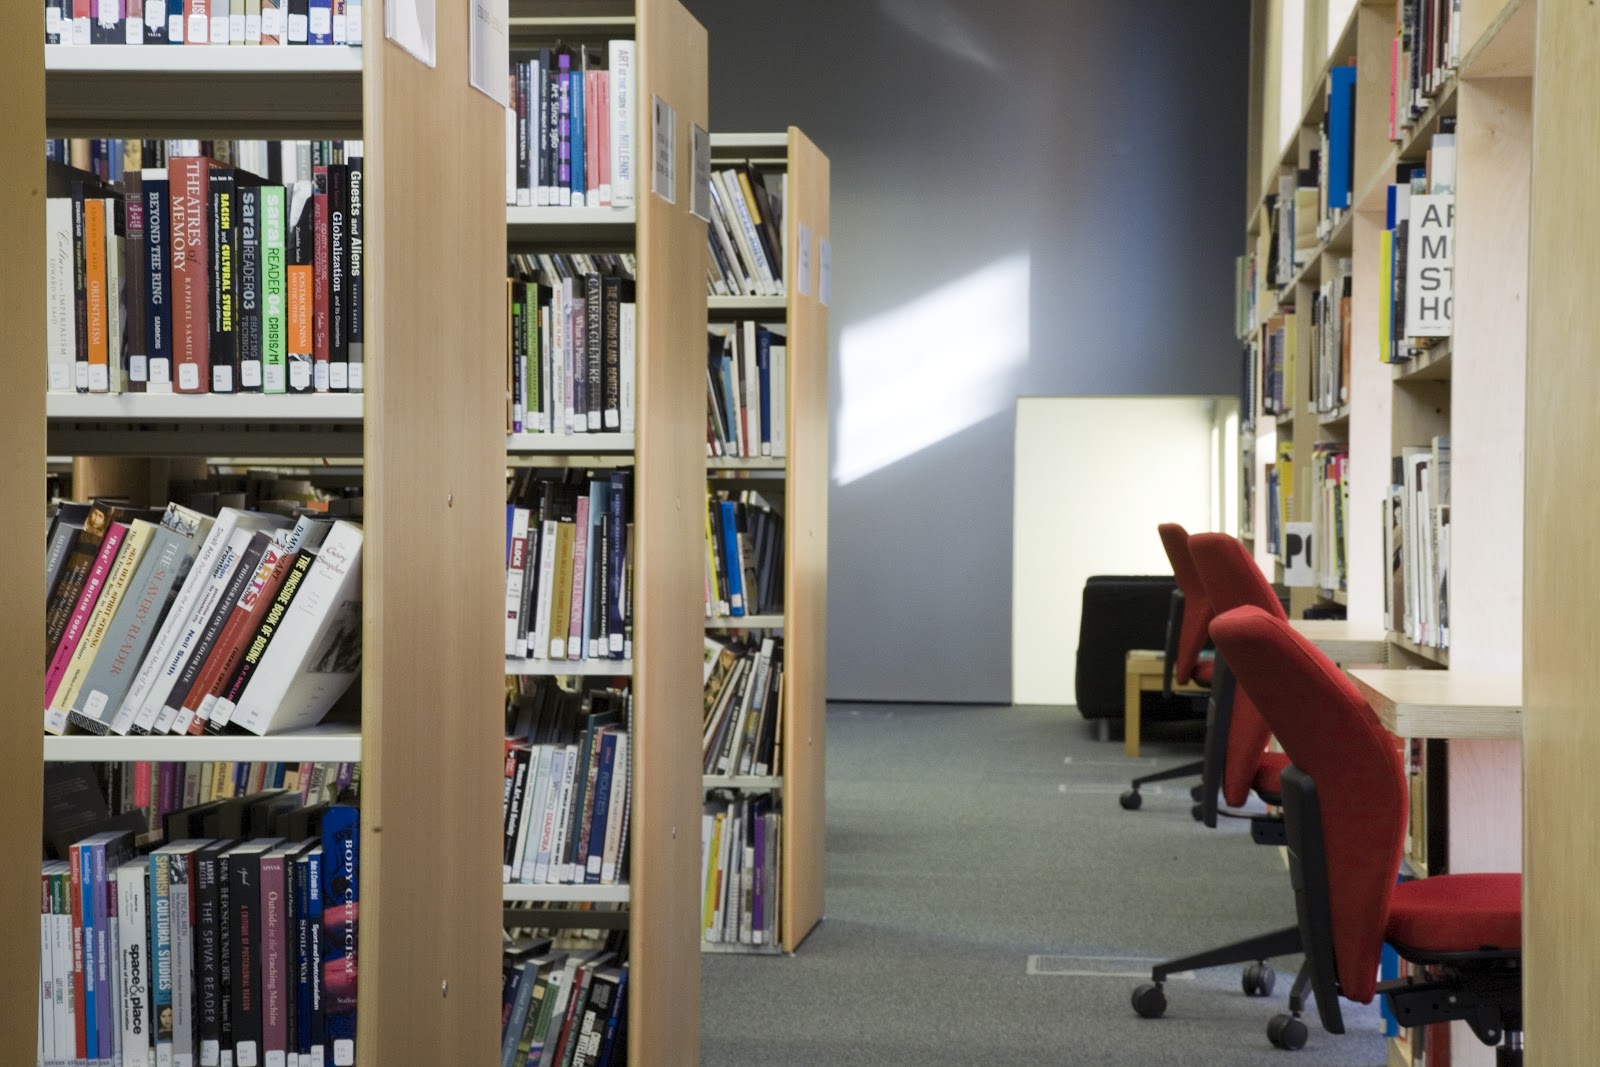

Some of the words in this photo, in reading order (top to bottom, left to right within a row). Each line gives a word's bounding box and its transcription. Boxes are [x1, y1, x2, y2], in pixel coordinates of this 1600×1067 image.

[618, 50, 629, 68] ART
[551, 84, 560, 98] Art
[550, 102, 560, 126] Since
[549, 128, 559, 149] 1960
[186, 160, 201, 247] THEATRES
[350, 171, 362, 216] Guests
[148, 192, 161, 244] BEYOND
[221, 193, 230, 230] RACISM
[351, 218, 359, 236] and
[171, 196, 186, 272] MEMORY
[151, 246, 161, 268] THE
[186, 249, 201, 264] of
[221, 244, 231, 292] CULTURAL
[332, 211, 343, 292] Globalization
[350, 238, 362, 276] Aliens
[152, 272, 162, 305] RING
[184, 277, 192, 320] RAPHAEL
[588, 278, 599, 331] CAMERA
[90, 280, 101, 345] ORIENTALISM
[222, 294, 232, 332] STUDIES
[298, 272, 307, 348] POSTMODERNISM
[575, 316, 584, 338] What
[154, 316, 162, 350] SAMMONS
[184, 324, 193, 362] SAMUEL
[250, 316, 258, 357] SHAPING
[45, 533, 66, 573] SILVERMAN
[159, 538, 180, 568] THE
[202, 544, 215, 561] Acts
[210, 526, 225, 546] Small
[514, 538, 522, 567] BLOCK
[125, 546, 137, 566] SKIN
[210, 544, 234, 580] Frontier
[217, 553, 236, 581] Urban
[294, 552, 312, 571] THE
[133, 566, 167, 623] SLAVERY
[218, 562, 251, 615] PHOTOGRAPHY
[241, 548, 281, 608] ARTS
[276, 568, 304, 606] RINGSIDE
[212, 614, 223, 626] ON
[259, 623, 274, 637] OF
[265, 601, 285, 627] BOOK
[90, 617, 107, 649] STRONG
[109, 622, 142, 677] READER
[181, 628, 196, 649] Neil
[204, 625, 217, 642] THE
[244, 633, 268, 665] BOXING
[165, 648, 185, 677] Smith
[191, 640, 209, 666] COLOR
[181, 664, 196, 684] LINE
[565, 751, 575, 784] CHOMSKY
[72, 851, 80, 884] Soundings
[84, 851, 92, 885] Soundings
[96, 850, 104, 882] Soundings
[155, 855, 170, 897] SPANISH
[346, 840, 354, 884] BODY
[42, 880, 50, 914] Soundings
[54, 880, 62, 914] Soundings
[181, 892, 189, 918] TYPICAL
[202, 900, 213, 924] THE
[268, 891, 278, 928] Outside
[156, 899, 171, 948] CULTURAL
[182, 920, 190, 937] MEN
[241, 910, 250, 935] CRITIQUE
[311, 924, 321, 944] Sport
[346, 888, 354, 974] CRITICISM
[202, 930, 214, 972] SPIVAK
[242, 946, 251, 988] POSTCOLONIAL
[158, 950, 172, 991] STUDIES
[268, 953, 278, 989] Teaching
[300, 963, 309, 984] WAR
[312, 957, 321, 1010] Postcolonialism
[204, 977, 215, 1023] READER
[270, 990, 279, 1026] Machine
